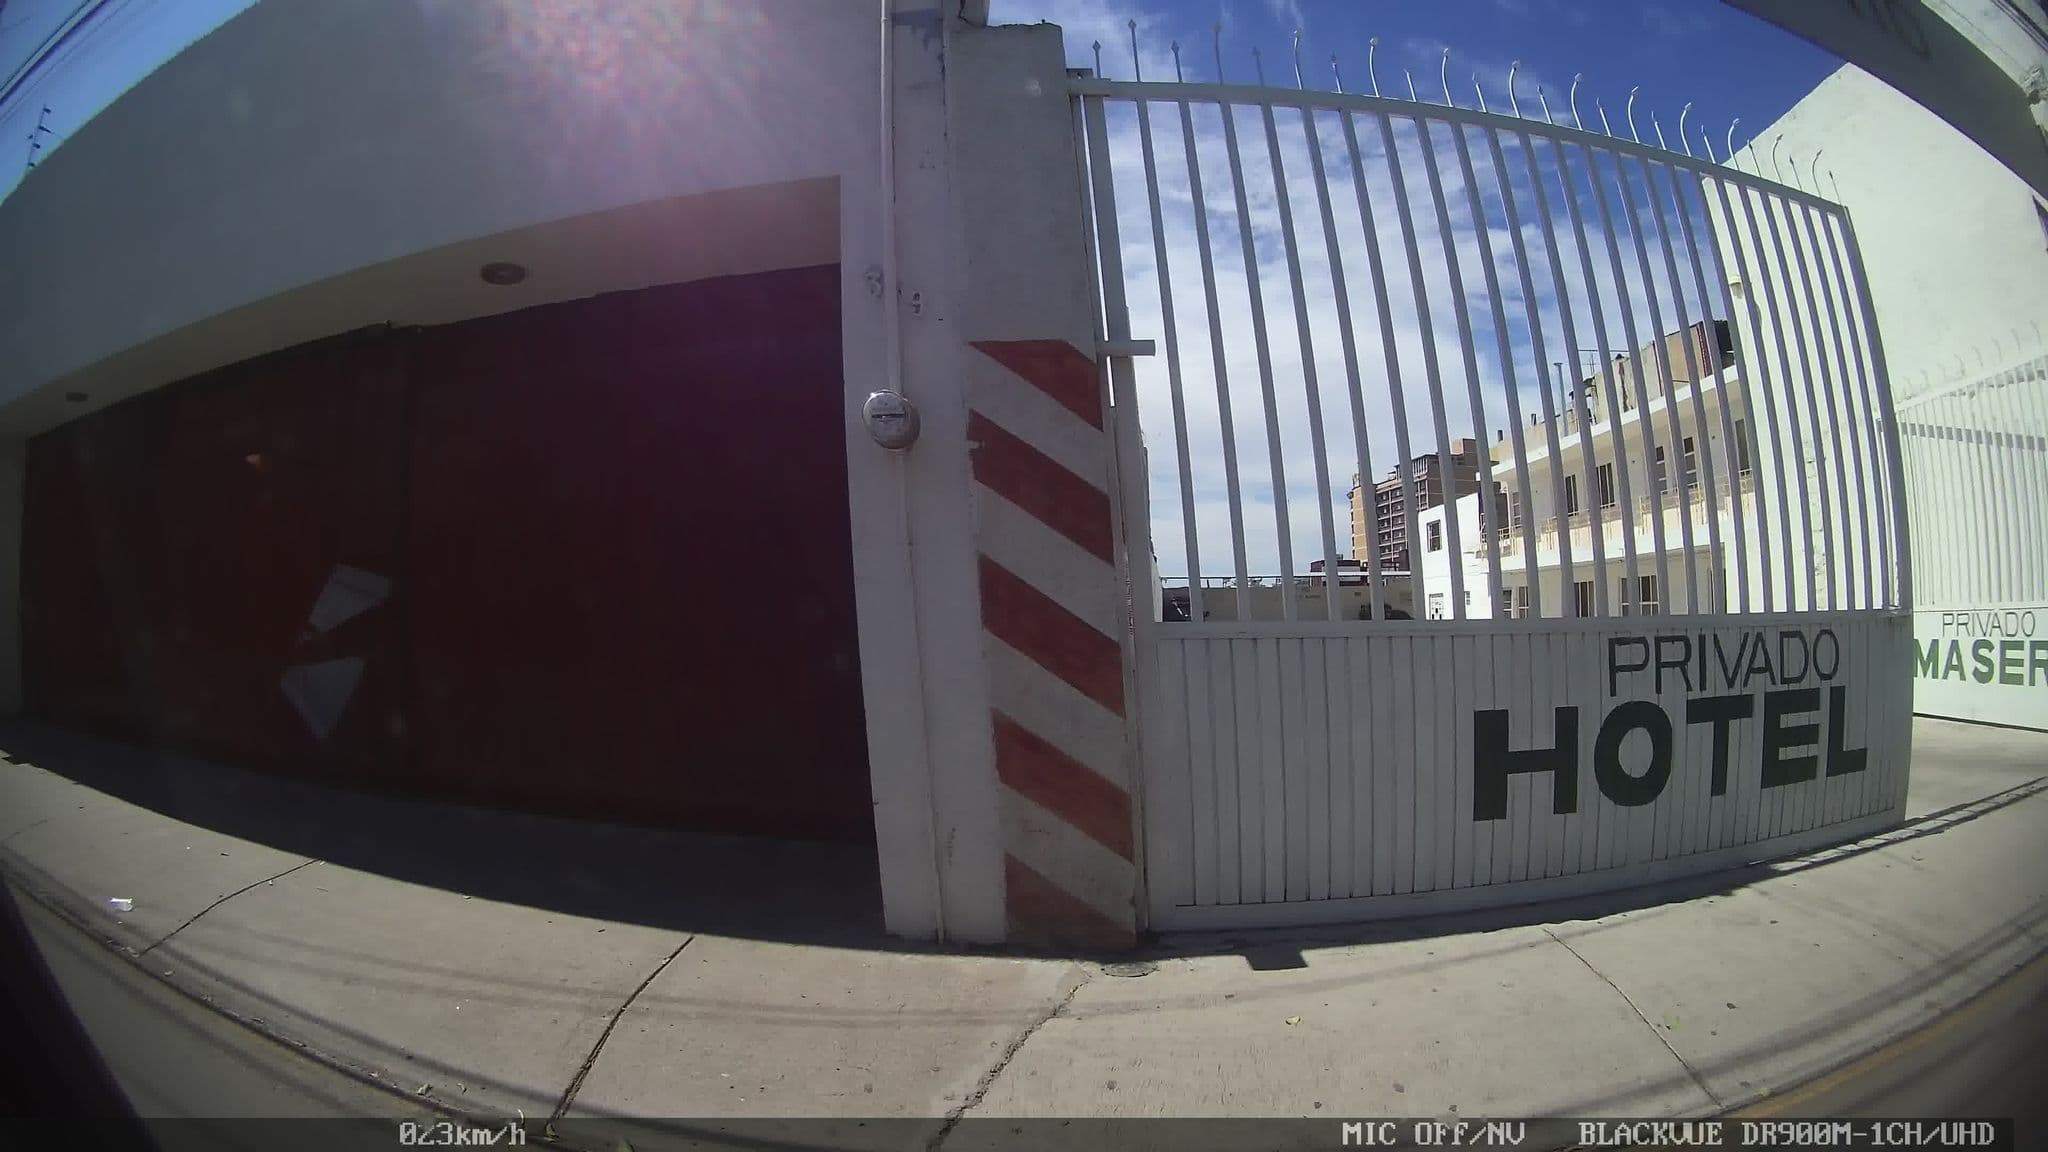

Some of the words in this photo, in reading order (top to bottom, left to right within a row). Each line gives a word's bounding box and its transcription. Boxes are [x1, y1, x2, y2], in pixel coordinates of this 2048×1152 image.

[1942, 611, 2036, 637] PRIVADO
[1609, 629, 1840, 696] PRIVADO
[1473, 686, 1868, 821] HOTEL
